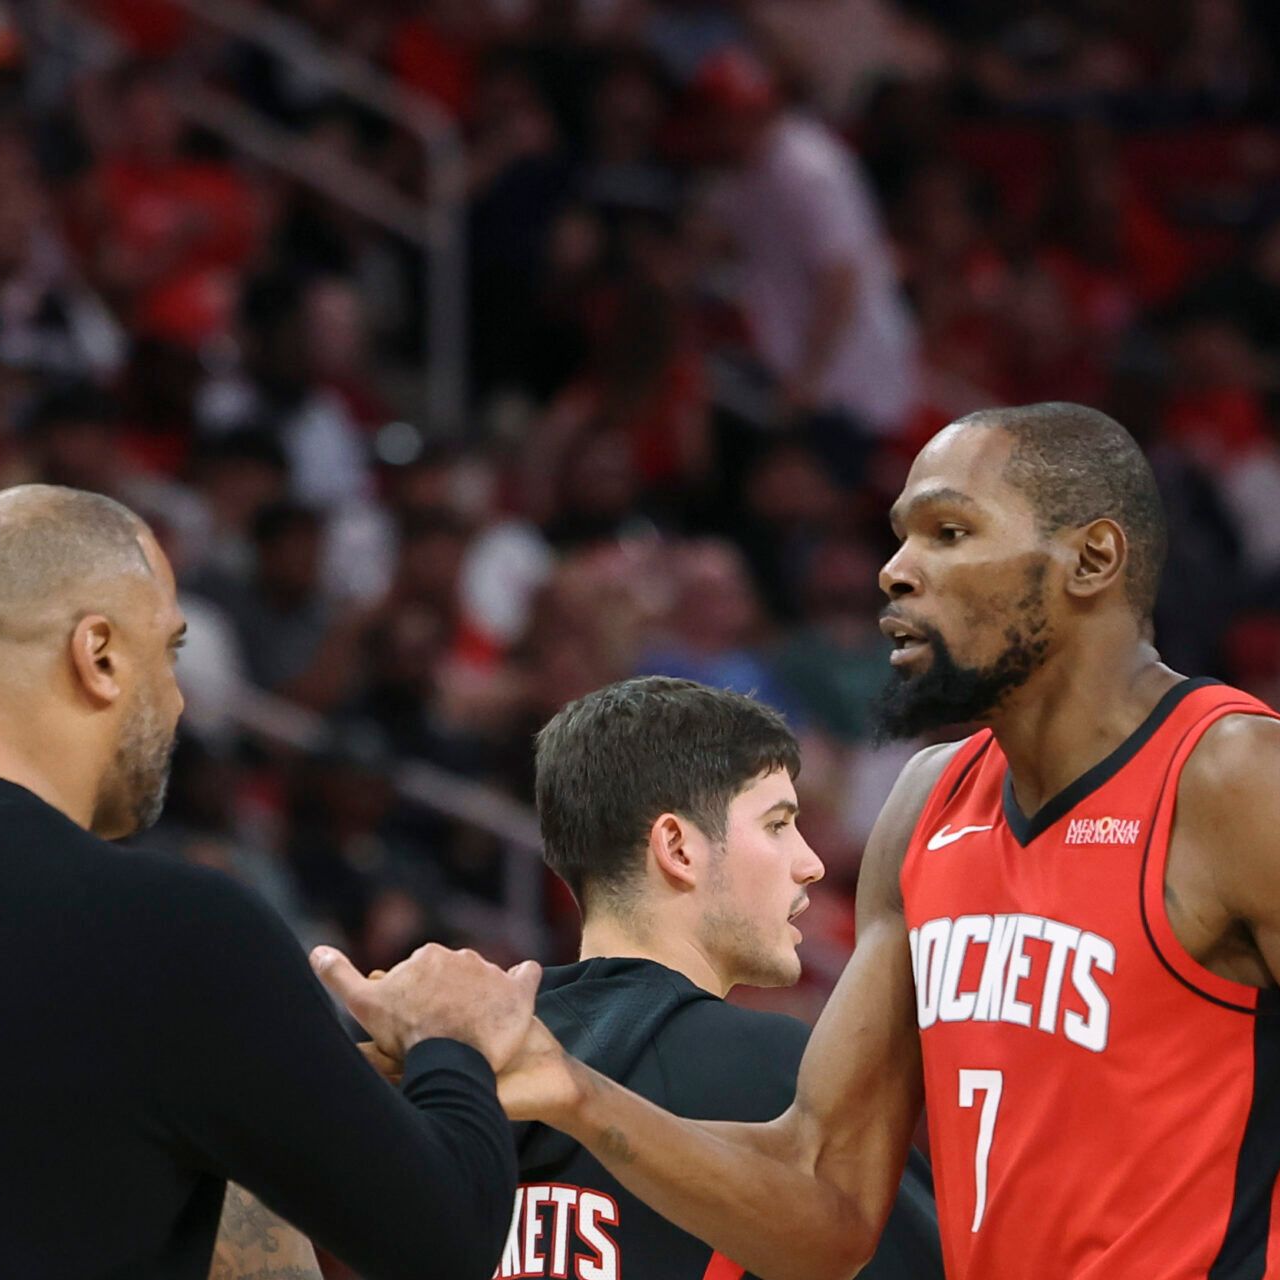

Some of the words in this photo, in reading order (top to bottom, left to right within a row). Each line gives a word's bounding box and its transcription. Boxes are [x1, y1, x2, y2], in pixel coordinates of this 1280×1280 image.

[1064, 829, 1139, 844] HERMANN
[1068, 816, 1140, 833] MEMORIAL
[909, 913, 1116, 1053] OCKETS
[959, 1069, 1003, 1233] 7
